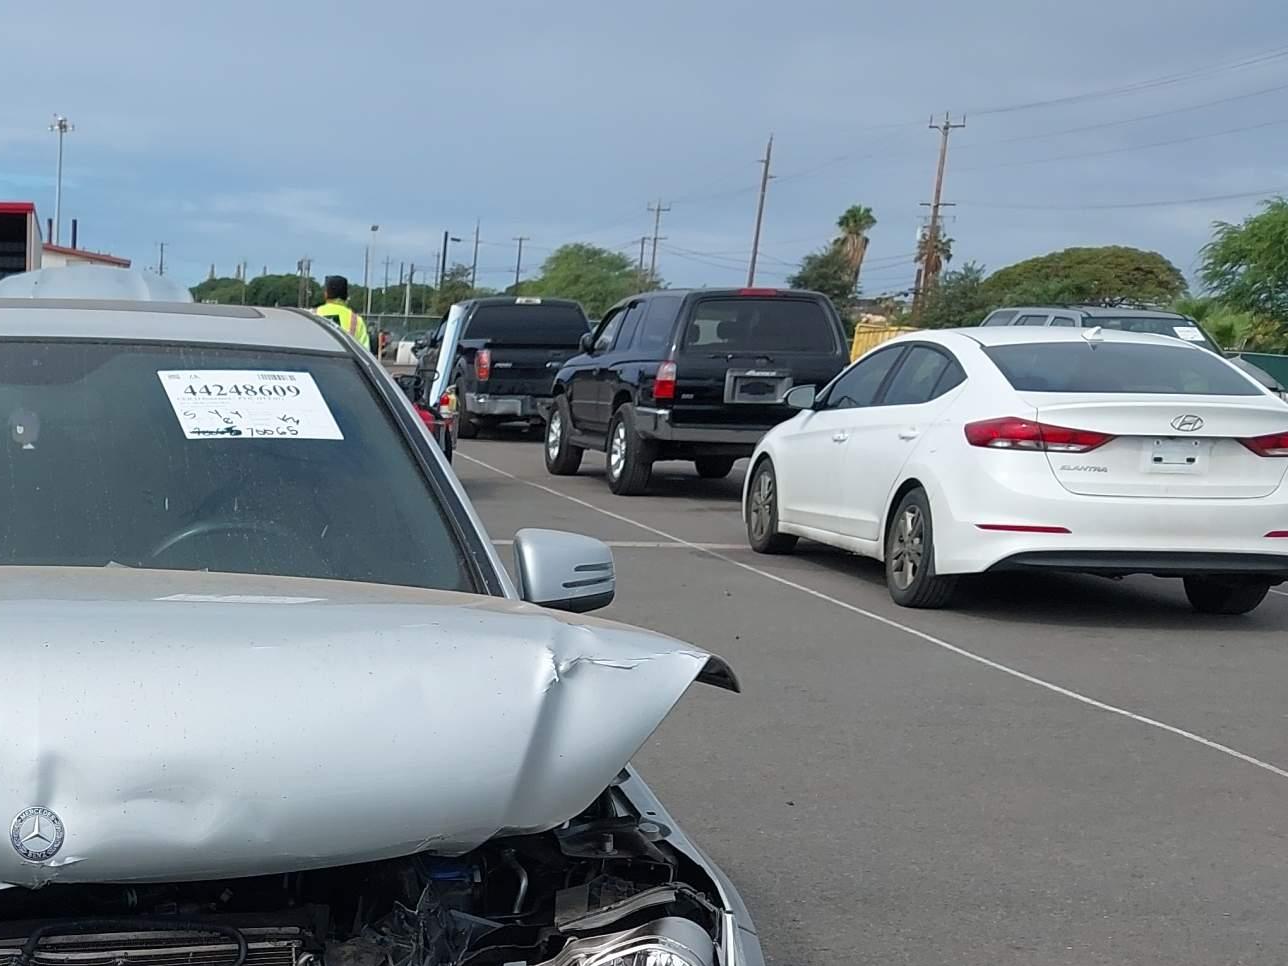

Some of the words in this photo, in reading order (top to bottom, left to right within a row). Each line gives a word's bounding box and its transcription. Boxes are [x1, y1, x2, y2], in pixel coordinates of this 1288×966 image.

[183, 384, 301, 398] 44248609
[1059, 464, 1108, 473] ELANTRA
[20, 808, 55, 821] MERCEDES
[27, 851, 49, 859] BENZ
